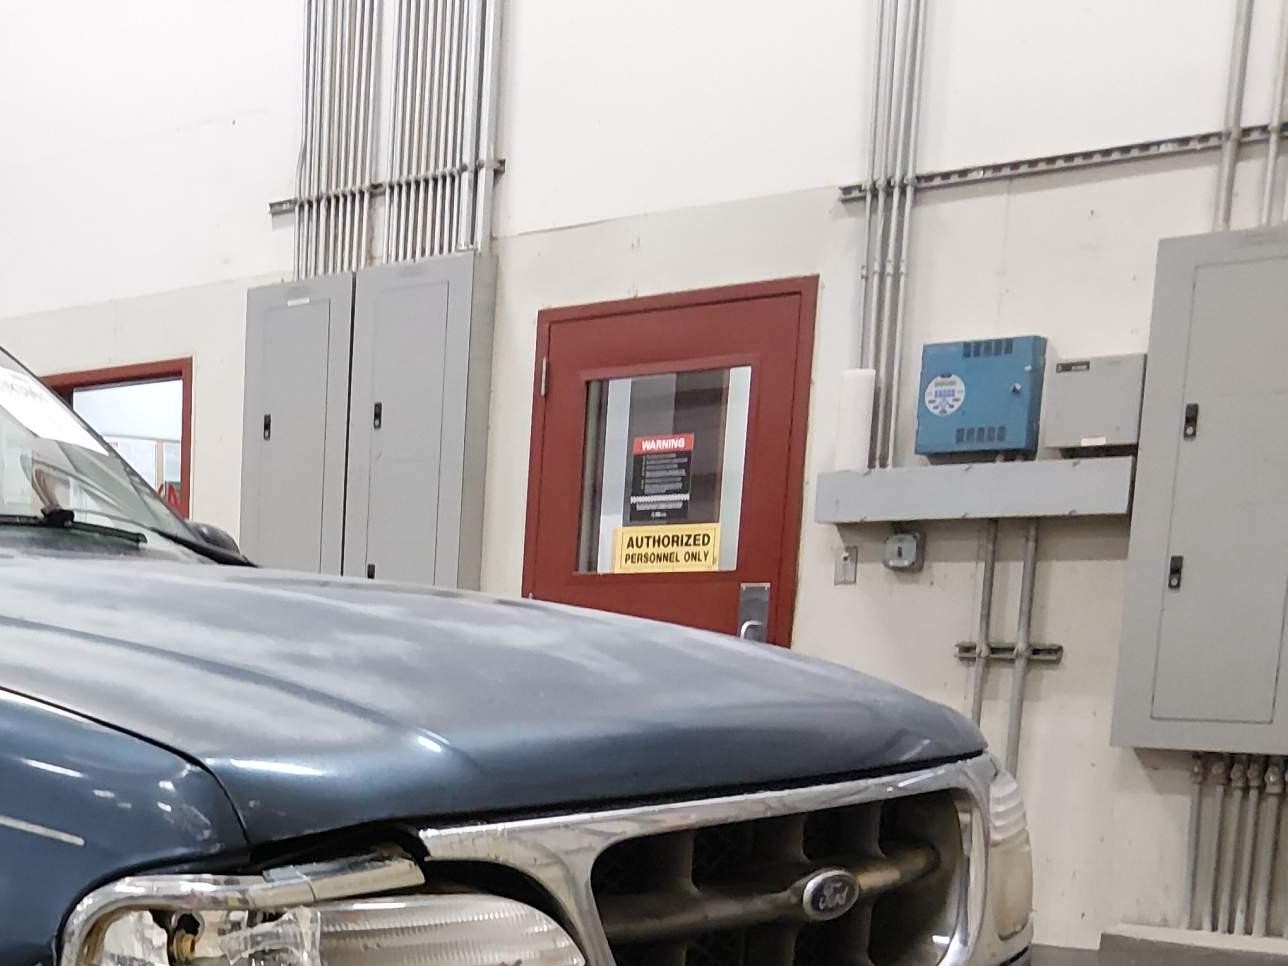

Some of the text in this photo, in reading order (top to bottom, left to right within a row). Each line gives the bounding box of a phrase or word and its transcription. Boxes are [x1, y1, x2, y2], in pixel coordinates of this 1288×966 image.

[641, 437, 686, 451] WARNING
[626, 533, 711, 549] AUTHORIZED
[624, 550, 710, 564] PERSONNEL ONLY
